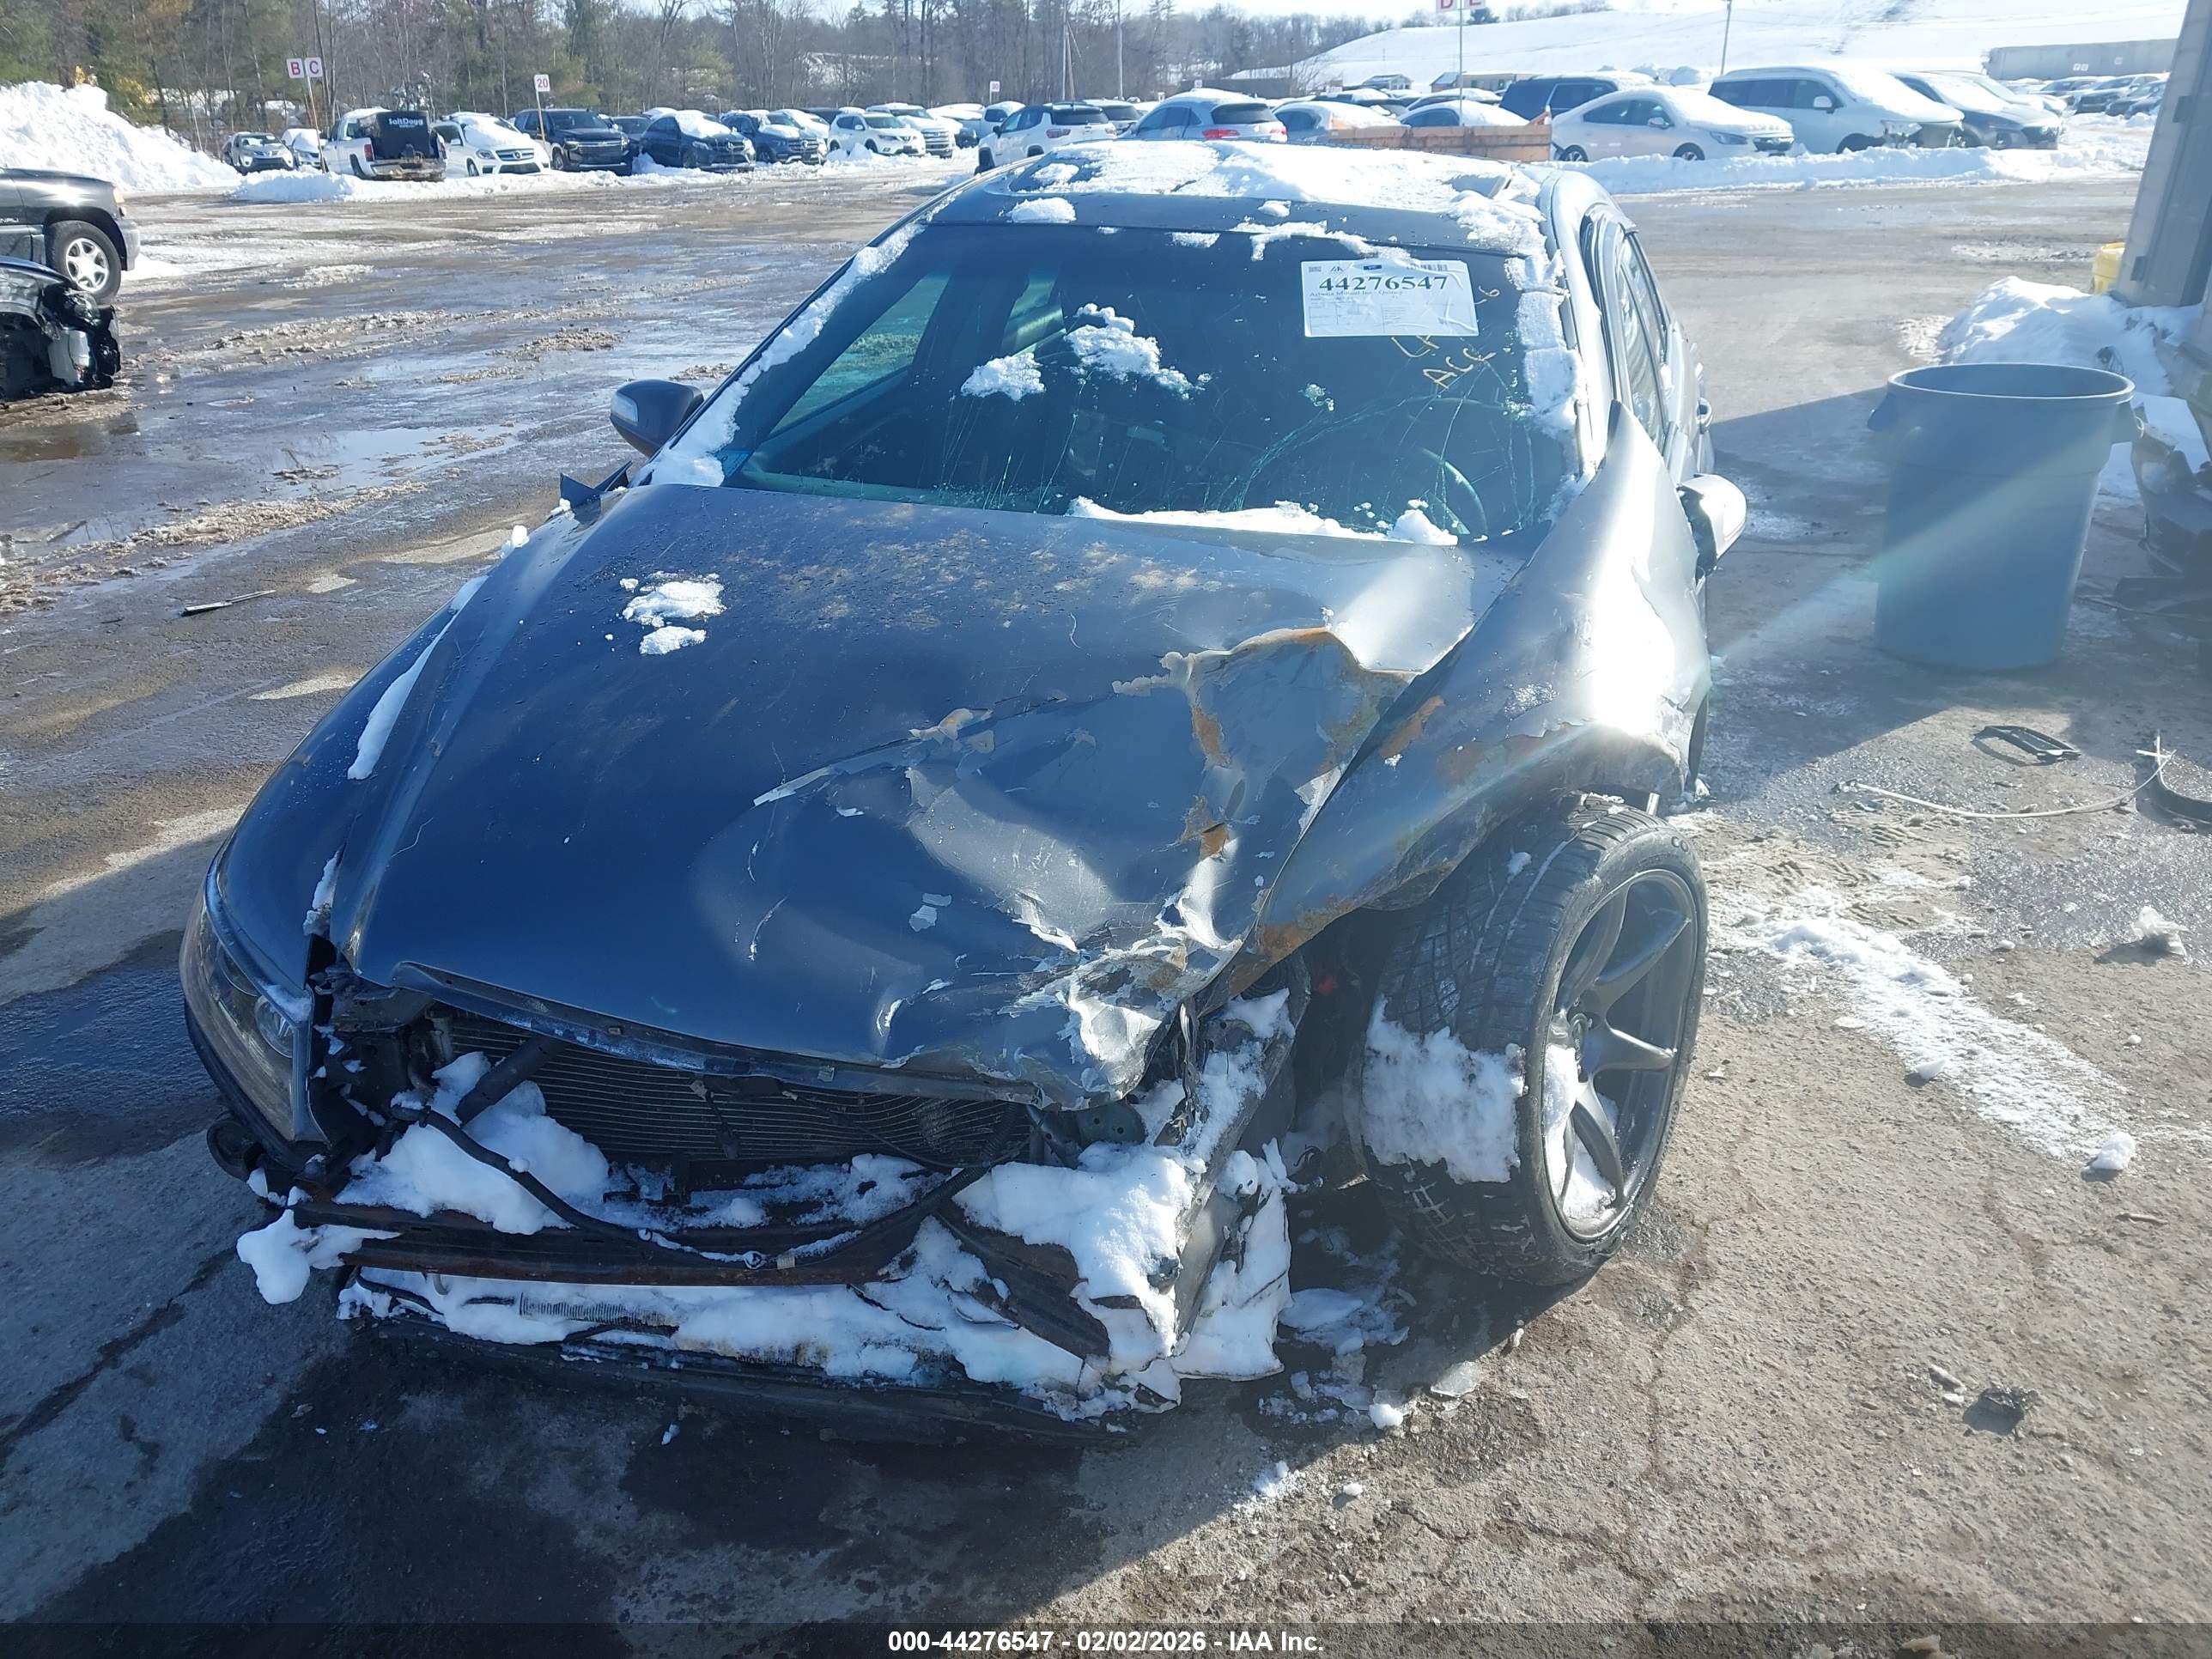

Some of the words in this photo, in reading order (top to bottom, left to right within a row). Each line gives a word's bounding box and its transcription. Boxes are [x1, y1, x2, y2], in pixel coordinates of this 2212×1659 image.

[290, 61, 301, 76] B
[309, 60, 319, 75] C
[537, 78, 549, 88] 20
[1319, 276, 1449, 291] 44276547
